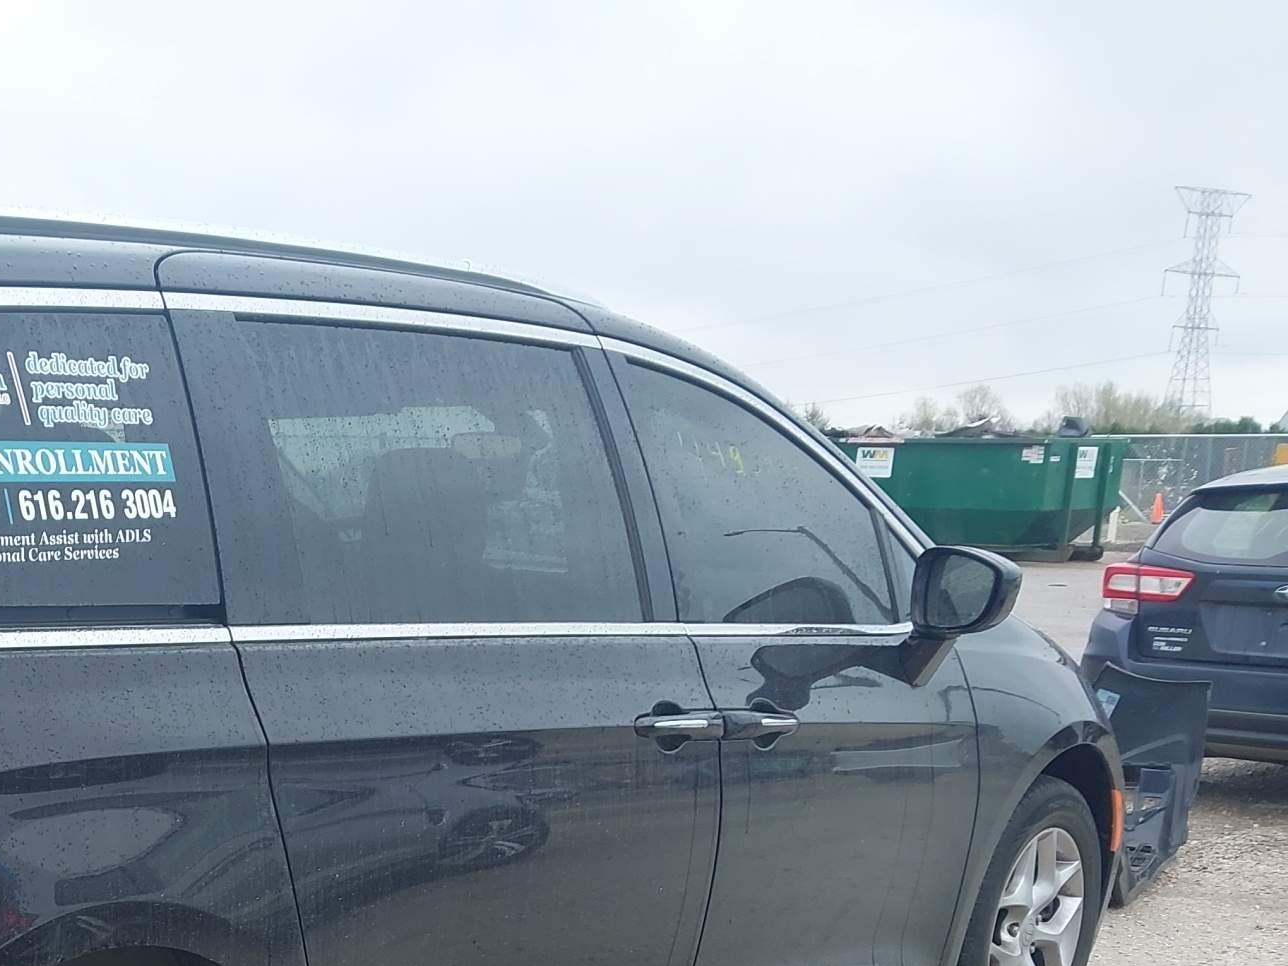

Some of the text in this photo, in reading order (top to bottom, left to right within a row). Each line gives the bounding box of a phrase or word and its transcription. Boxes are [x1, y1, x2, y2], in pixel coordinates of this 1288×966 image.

[25, 351, 149, 383] dedicated for
[30, 379, 118, 403] personal
[38, 400, 153, 428] quality care
[18, 488, 115, 521] 616.216
[121, 488, 176, 519] 3004
[39, 530, 79, 545] Assist
[82, 528, 113, 544] with
[115, 529, 151, 543] ADLS
[29, 548, 61, 562] Care
[64, 546, 120, 560] Services
